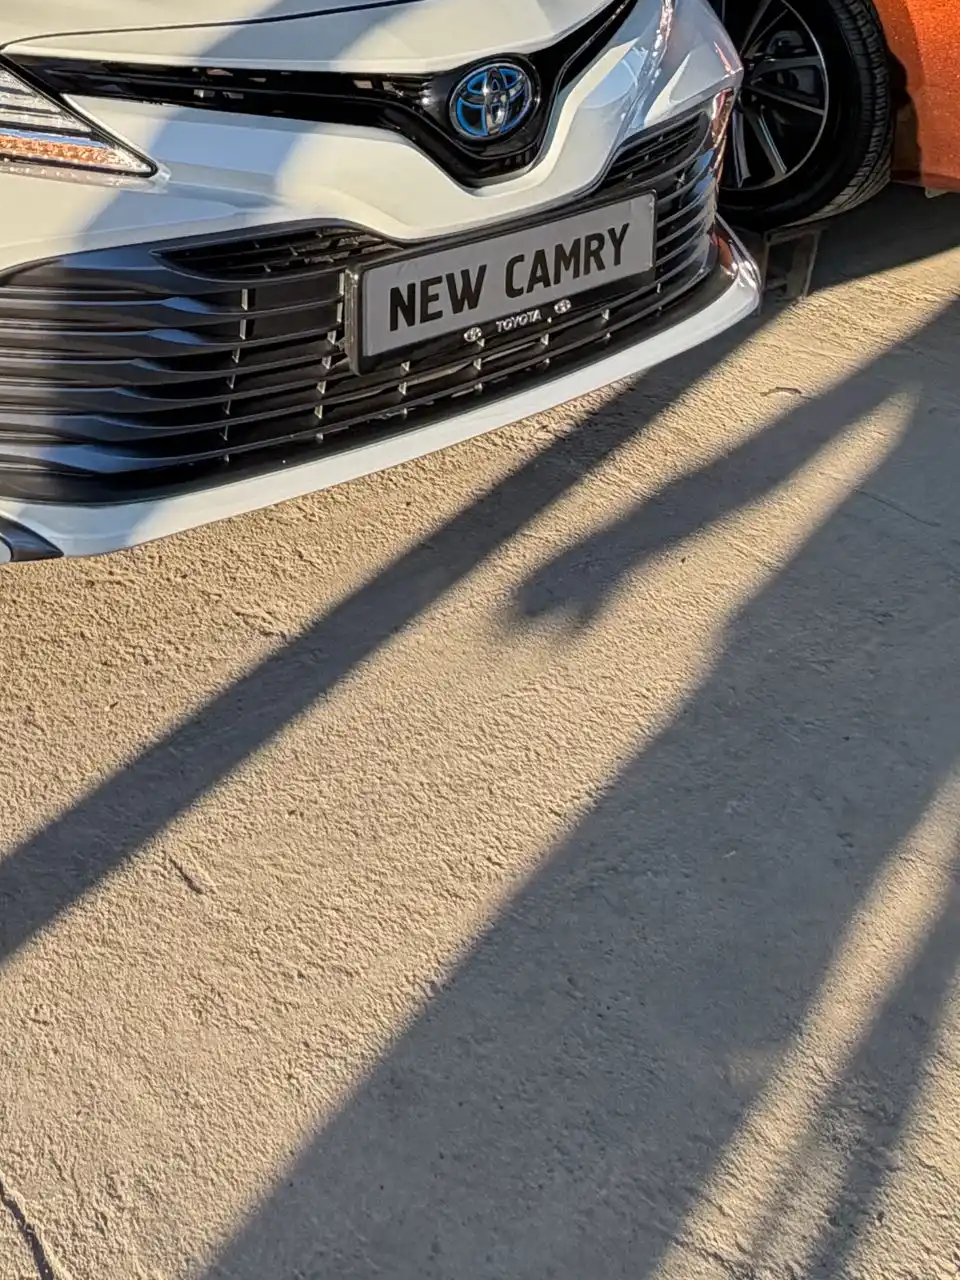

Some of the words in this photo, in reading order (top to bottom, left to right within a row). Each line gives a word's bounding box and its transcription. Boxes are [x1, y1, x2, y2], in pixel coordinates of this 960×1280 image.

[389, 263, 487, 332] NEW
[504, 223, 630, 299] CAMRY
[496, 308, 542, 333] TOYOTA
